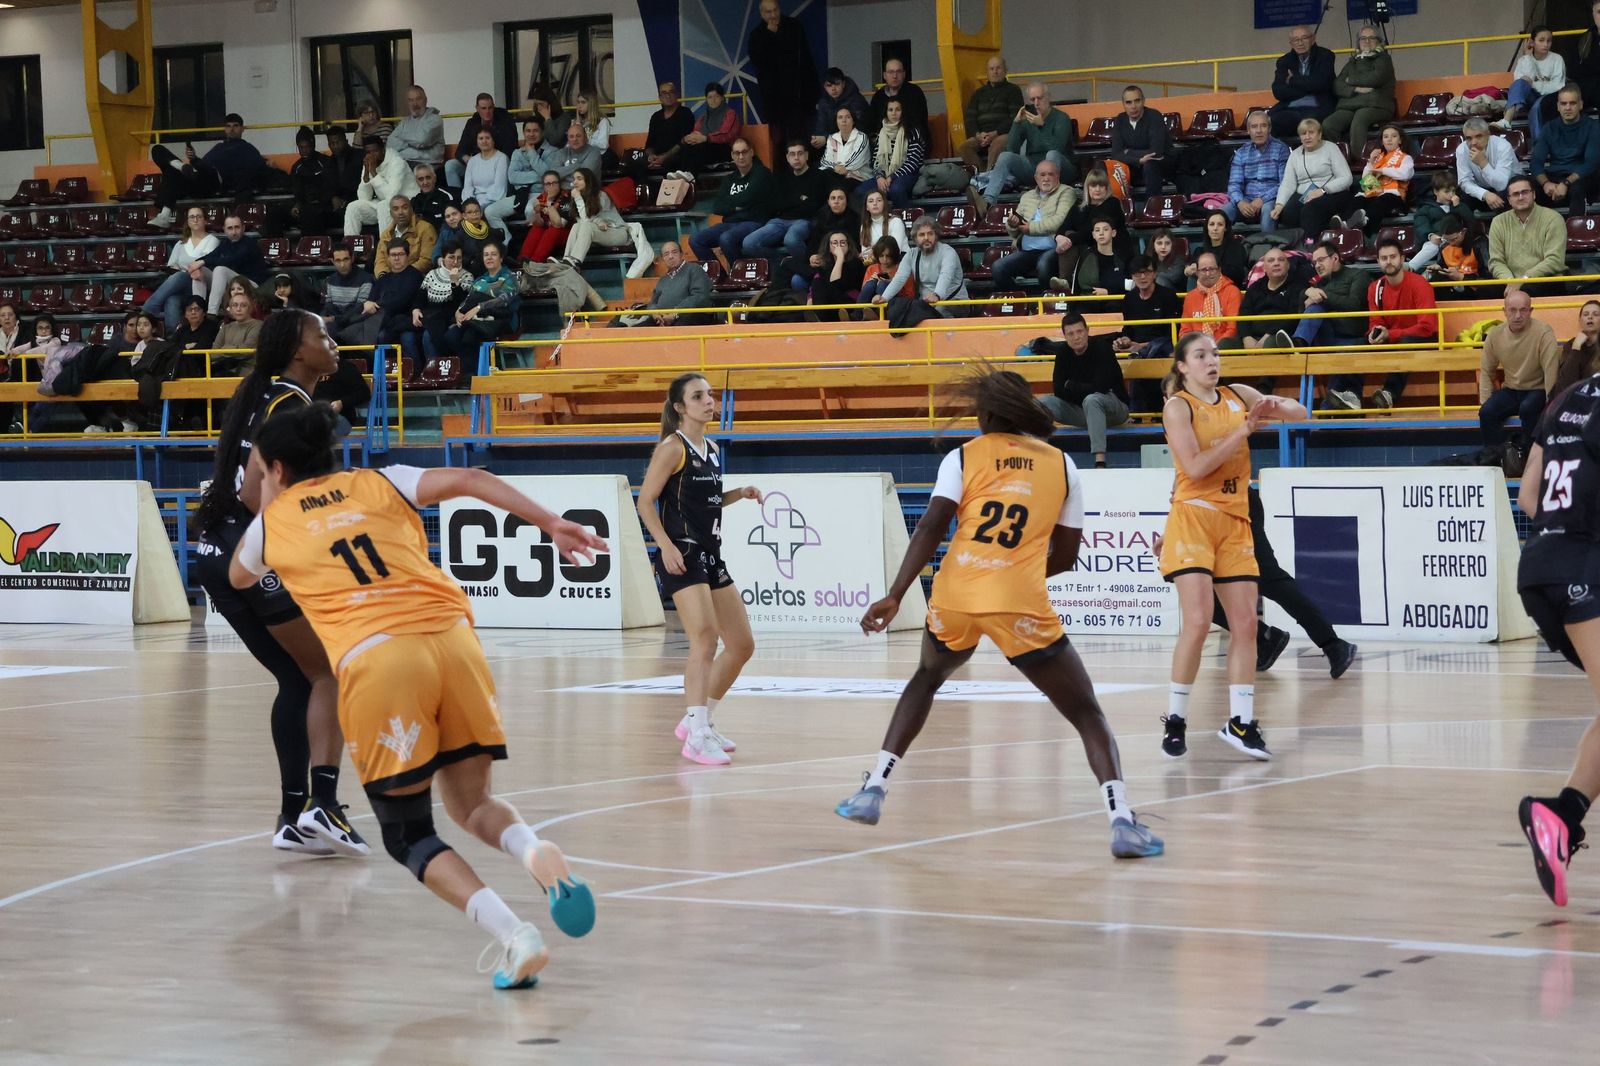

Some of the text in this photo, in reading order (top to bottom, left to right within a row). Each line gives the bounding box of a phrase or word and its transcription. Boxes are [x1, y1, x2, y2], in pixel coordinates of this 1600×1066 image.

[1429, 97, 1437, 107] 2
[1164, 198, 1172, 209] 8
[953, 207, 965, 218] 16
[1586, 219, 1595, 231] 9
[311, 239, 322, 247] 40
[1338, 235, 1344, 245] 1
[746, 262, 757, 270] 22
[124, 286, 134, 294] 46
[1541, 459, 1581, 513] 25
[1403, 485, 1485, 508] LUIS FELIPE
[1103, 510, 1136, 518] Asesoria
[971, 499, 1030, 550] 23
[1437, 516, 1486, 543] GÓMEZ
[330, 532, 390, 586] 11
[1070, 551, 1161, 573] NDRÉ
[1423, 554, 1488, 578] FERRERO
[1, 578, 129, 589] EL CENTRO COMERCIAL DE ZAMORA
[1065, 584, 1075, 593] 17
[1077, 584, 1095, 593] Entr
[1096, 584, 1101, 593] 1
[1109, 584, 1135, 593] 49008
[1137, 584, 1171, 593] Zamora
[559, 586, 611, 599] CRUCES
[741, 581, 870, 608] oletas salud
[1084, 614, 1105, 627] 605
[1110, 614, 1125, 627] 76
[1128, 615, 1142, 627] 71
[1147, 615, 1161, 627] 05
[1403, 604, 1488, 629] ABOGADO
